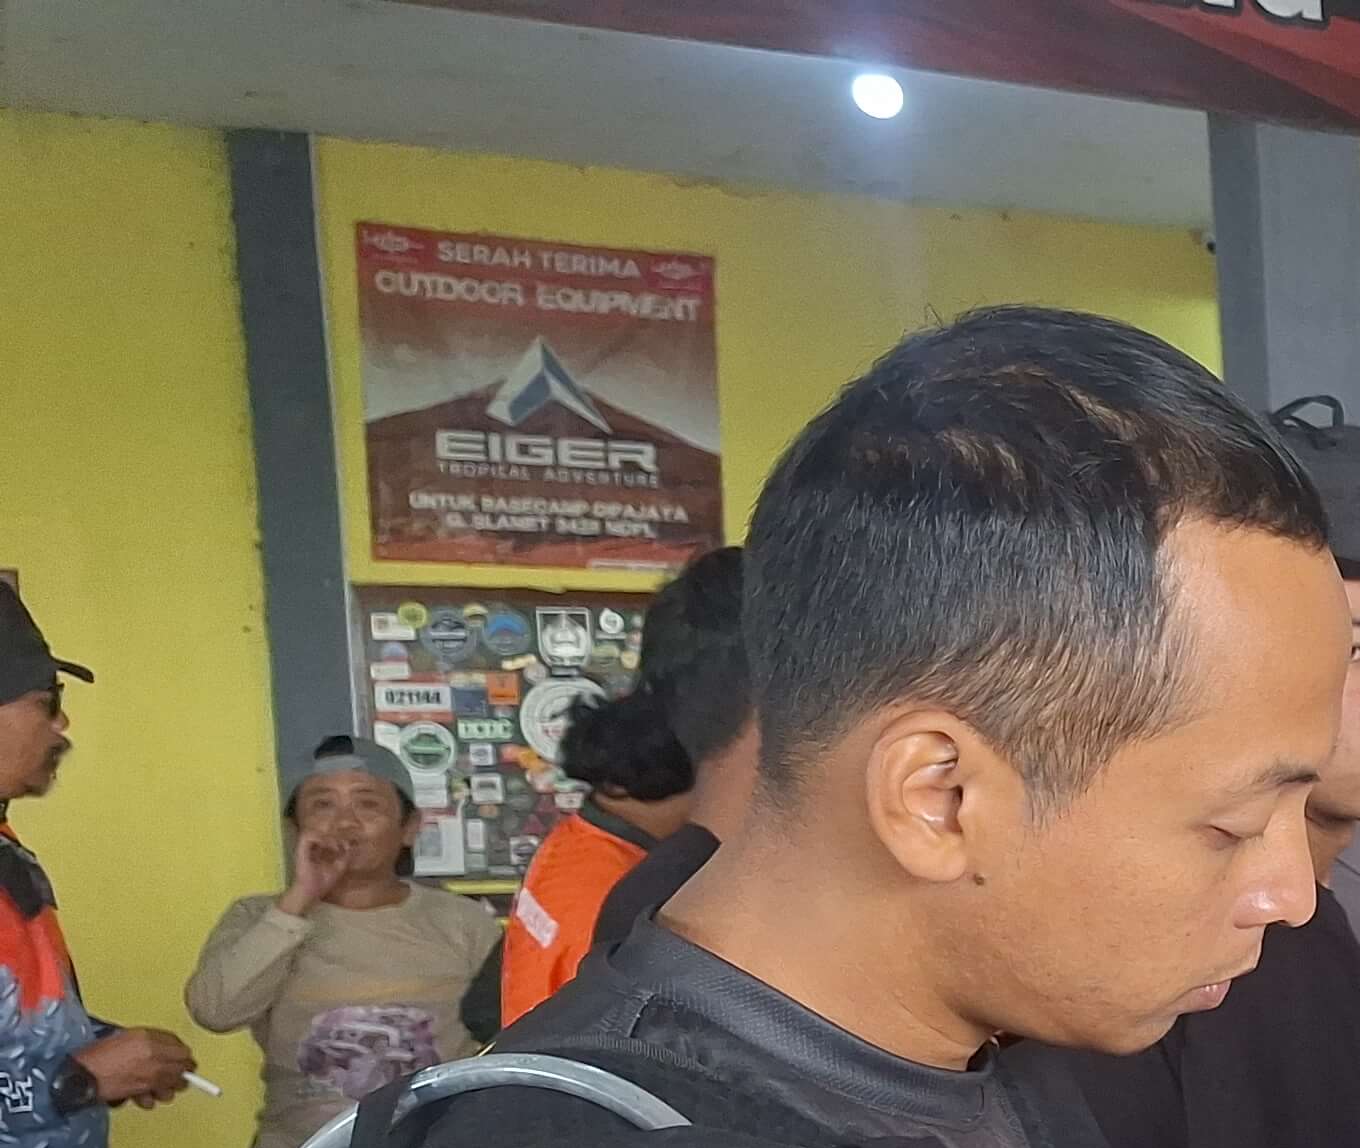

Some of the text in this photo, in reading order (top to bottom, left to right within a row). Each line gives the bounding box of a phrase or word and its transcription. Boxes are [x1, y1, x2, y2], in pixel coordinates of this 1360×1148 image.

[437, 240, 641, 279] SERAH TERIMA
[375, 270, 700, 321] OUTDOOR EQUIPMENT
[435, 430, 657, 473] EIGER
[409, 490, 478, 512] UNTUK
